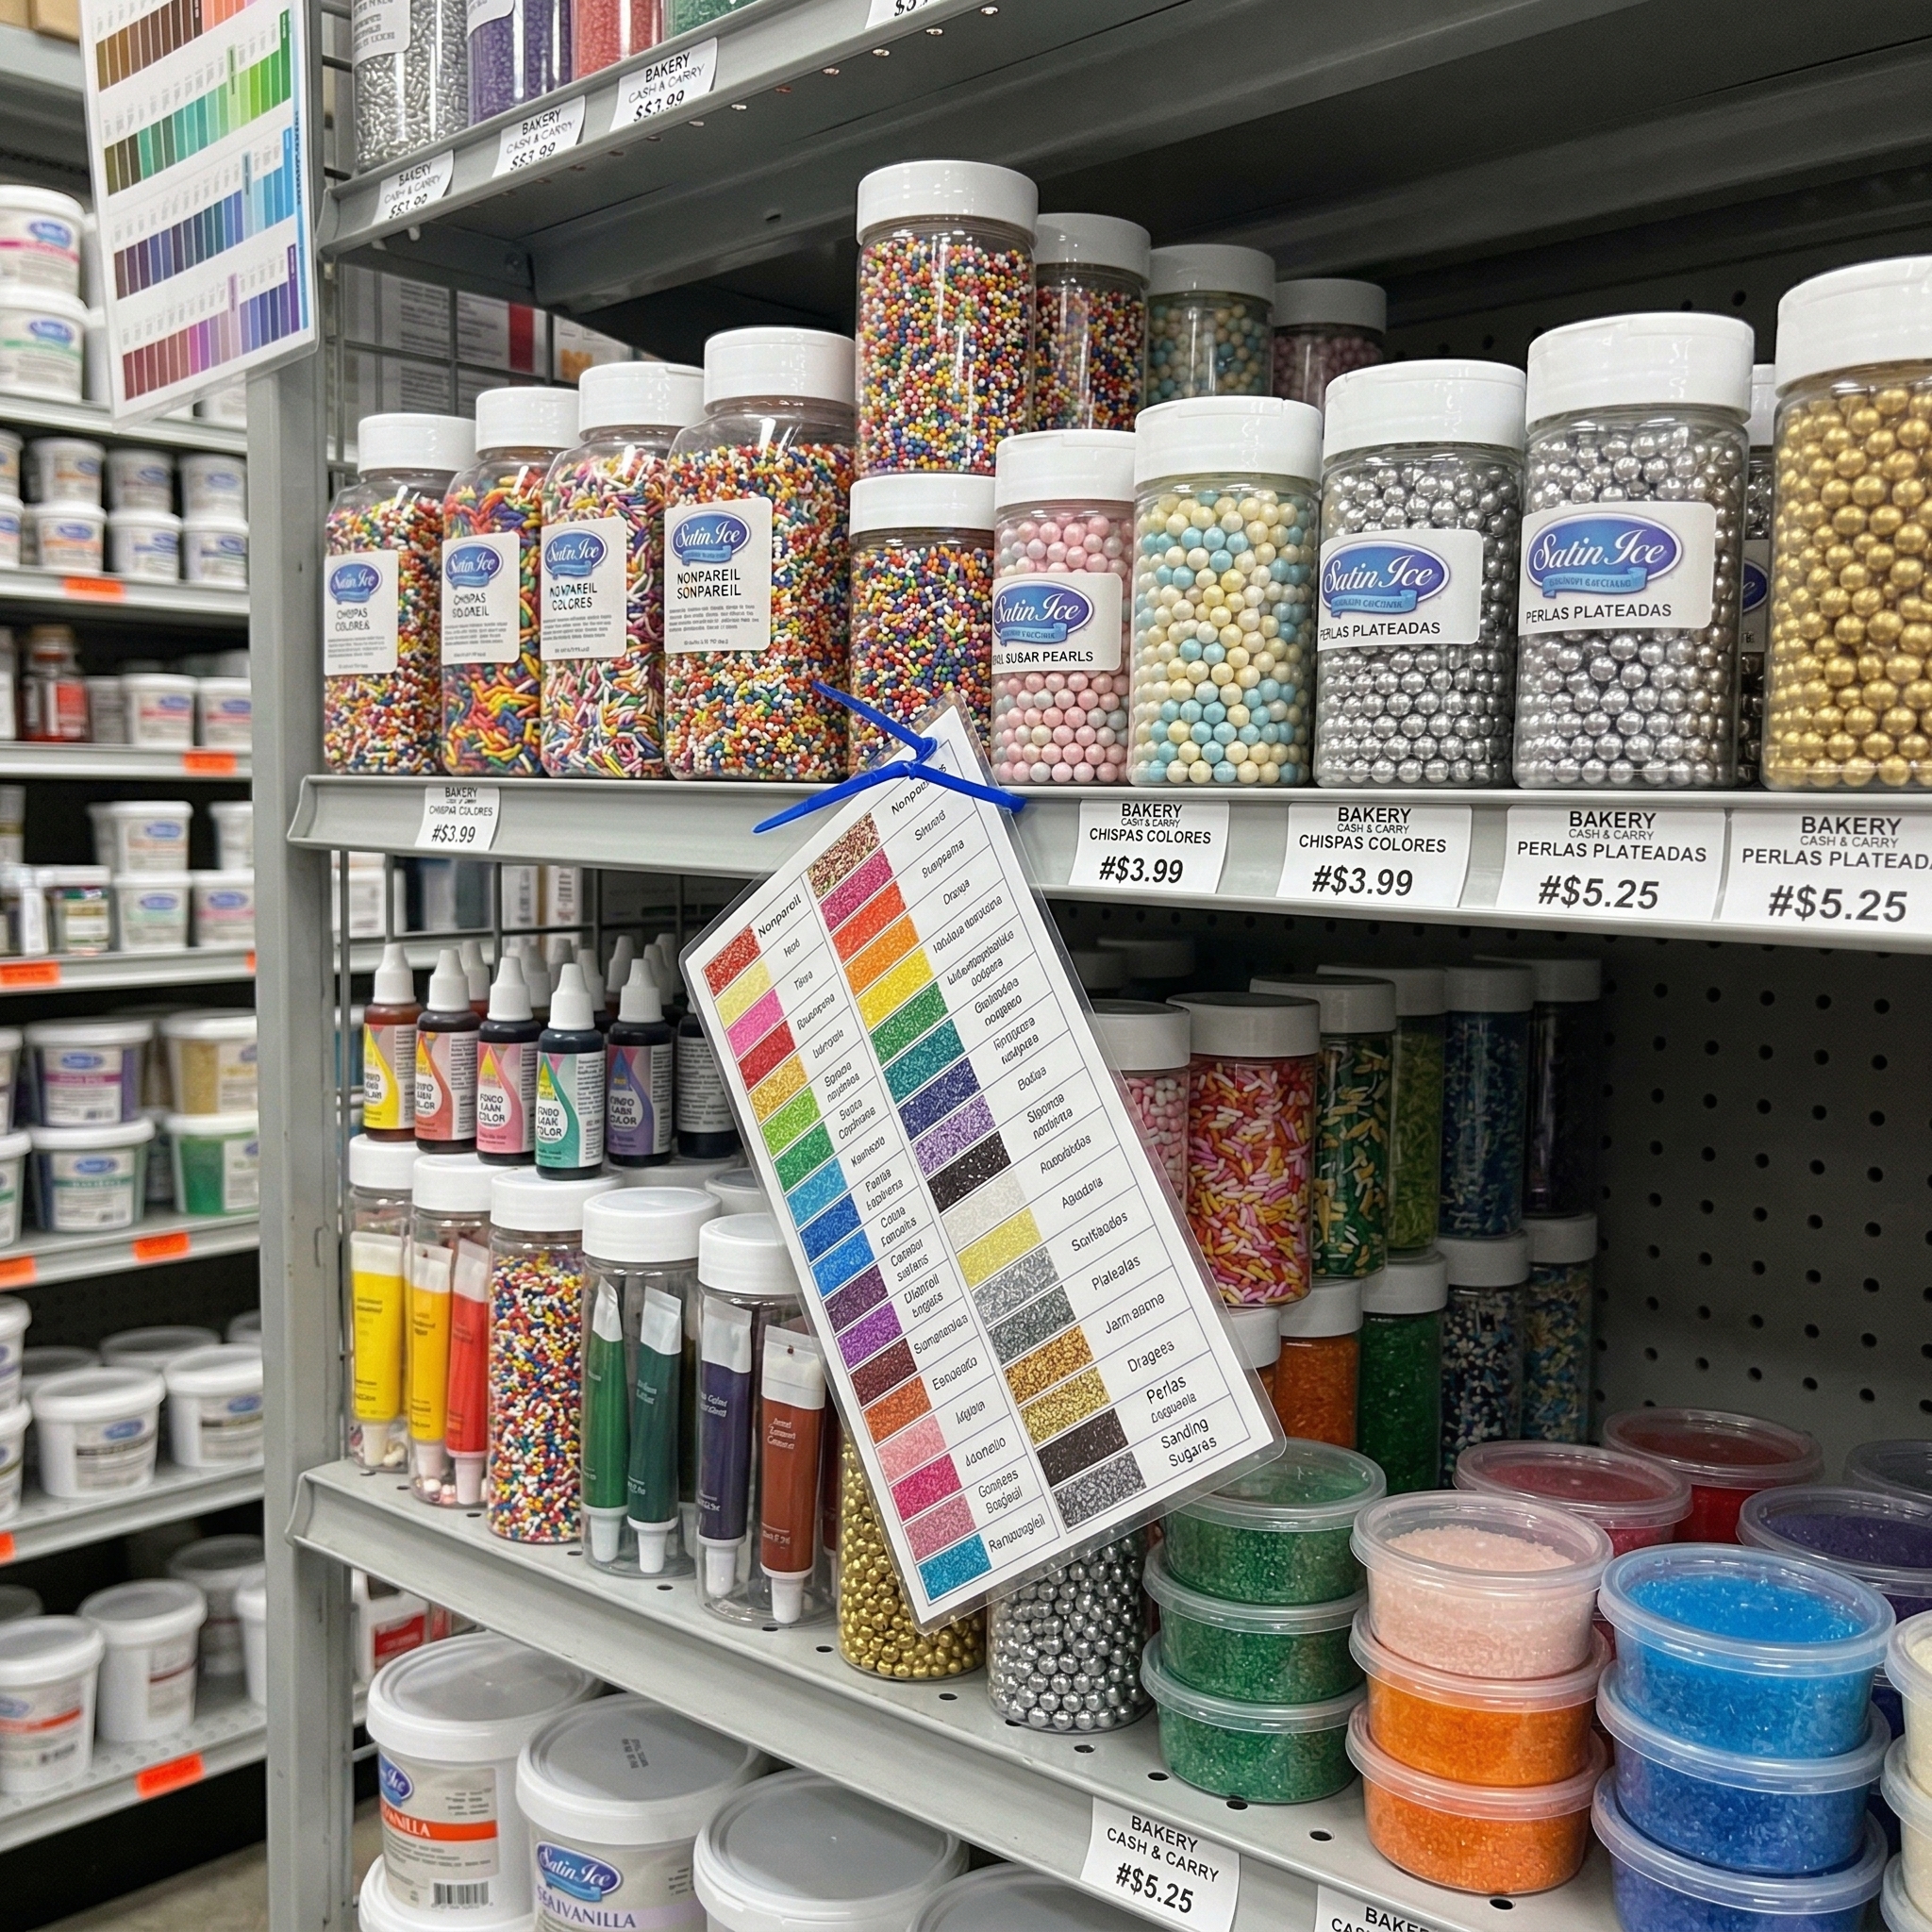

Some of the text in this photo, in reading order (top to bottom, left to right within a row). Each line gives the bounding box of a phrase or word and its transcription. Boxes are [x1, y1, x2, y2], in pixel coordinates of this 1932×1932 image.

[645, 51, 691, 83] BAKERY
[668, 63, 706, 88] CARRY
[522, 108, 561, 136] BAKERY
[675, 521, 741, 547] Satin Ice
[1533, 529, 1667, 572] Satin Ice
[676, 568, 741, 585] NONPAREIL
[1324, 555, 1439, 593] Satin Ice
[676, 584, 741, 600] SONPAREIL
[995, 592, 1082, 625] Satin Ice
[1525, 603, 1673, 625] PERLAS PLATEADAS
[1353, 622, 1441, 638] PLATEADAS
[1042, 651, 1093, 662] PEARLS
[1122, 803, 1183, 819] BAKERY
[1338, 807, 1412, 824] BAKERY
[1569, 810, 1657, 829] BAKERY
[1090, 827, 1211, 844] CHISPAS COLORES
[1337, 824, 1410, 834] CASH & CARRY
[1568, 828, 1655, 841] CASH & CARRY
[1801, 816, 1902, 836] BAKERY
[1298, 834, 1447, 853] CHISPAS COLORES
[1517, 841, 1707, 862] PERLAS PLATEADAS
[1800, 835, 1899, 848] CASH & CARRY
[1099, 855, 1184, 884] #$3.99
[1741, 847, 1932, 870] PERLAS PLATEAD
[1311, 864, 1413, 896] #$3.99
[1538, 874, 1659, 909] #$5.25
[1768, 884, 1907, 923] #$5.25
[1145, 1374, 1188, 1405] Perlas
[1160, 1417, 1210, 1451] Sanding
[1130, 1814, 1199, 1854] BAKERY
[540, 1846, 611, 1887] Satin Ice
[1107, 1826, 1220, 1884] CASH & CARRY
[1115, 1861, 1194, 1914] #$5.25
